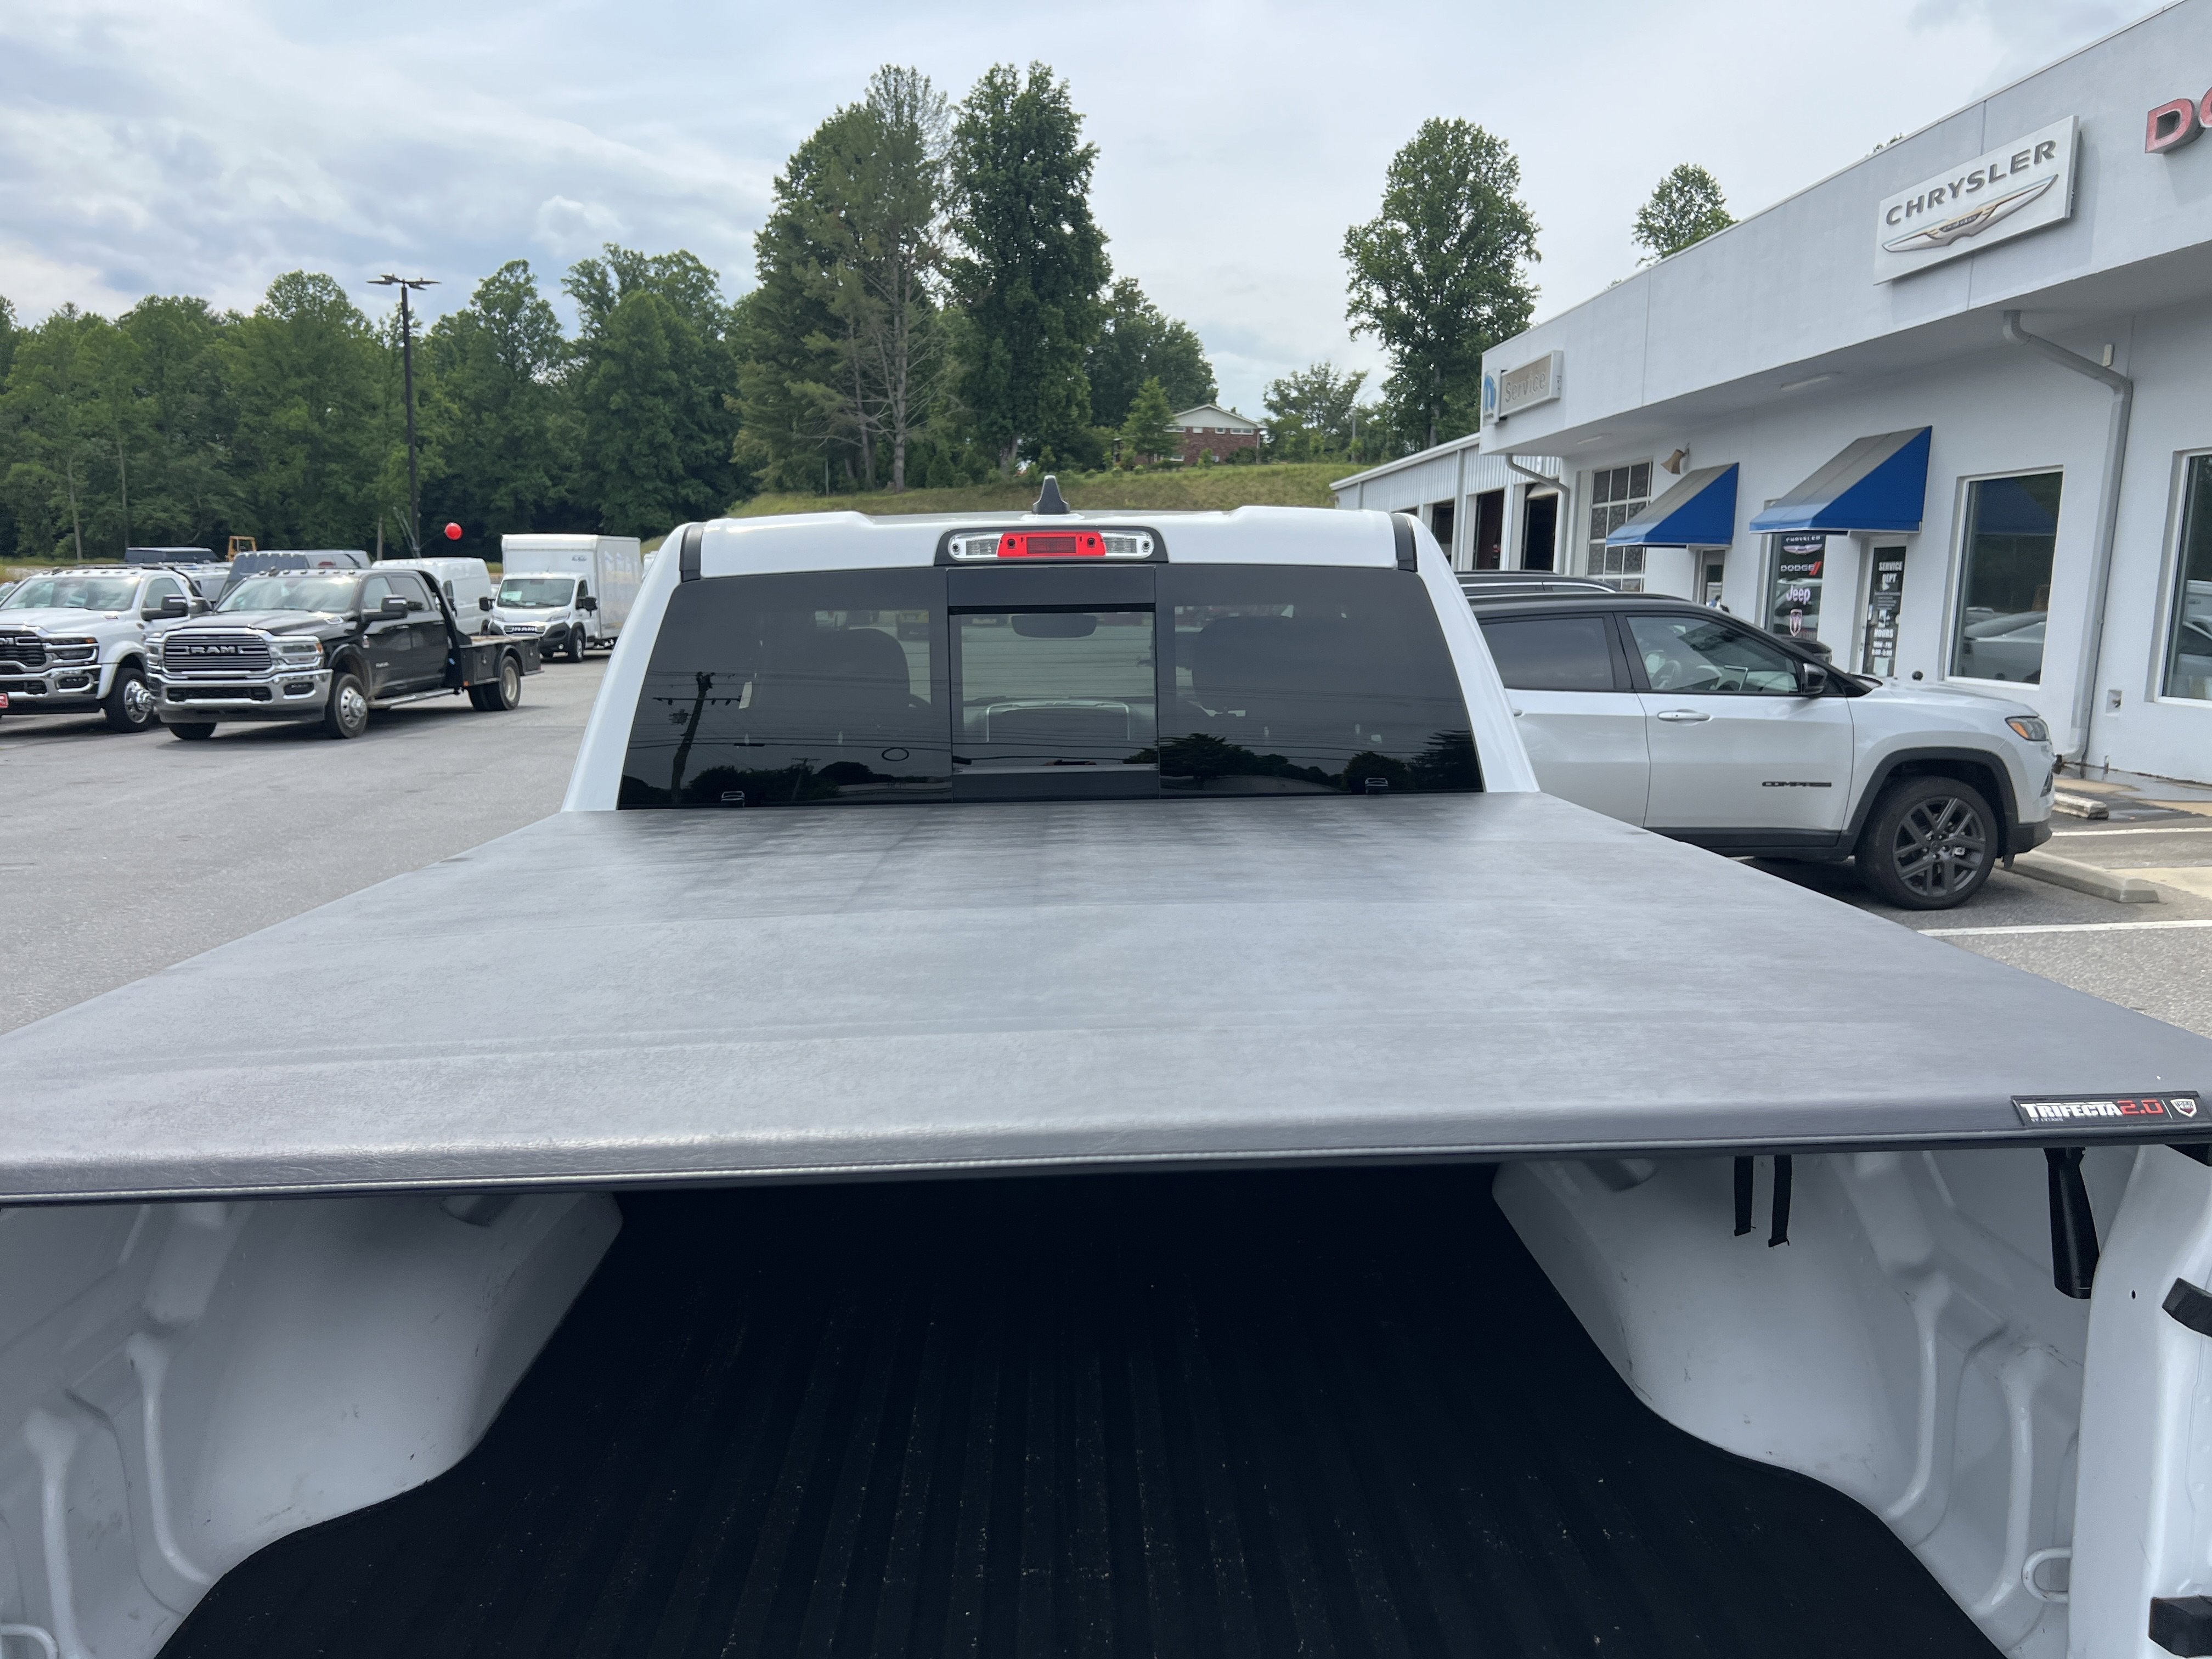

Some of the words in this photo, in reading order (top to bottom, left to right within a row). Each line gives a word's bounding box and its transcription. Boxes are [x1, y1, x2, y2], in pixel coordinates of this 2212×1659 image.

[2145, 87, 2212, 154] D
[1886, 140, 2057, 225] CHRYSLER
[1505, 373, 1546, 403] Service
[1781, 563, 1815, 572] DODGE
[1878, 561, 1903, 572] SERVICE
[1786, 584, 1810, 605] Jeep
[1874, 628, 1893, 638] HOURS
[2021, 1102, 2123, 1118] TRIFECTA
